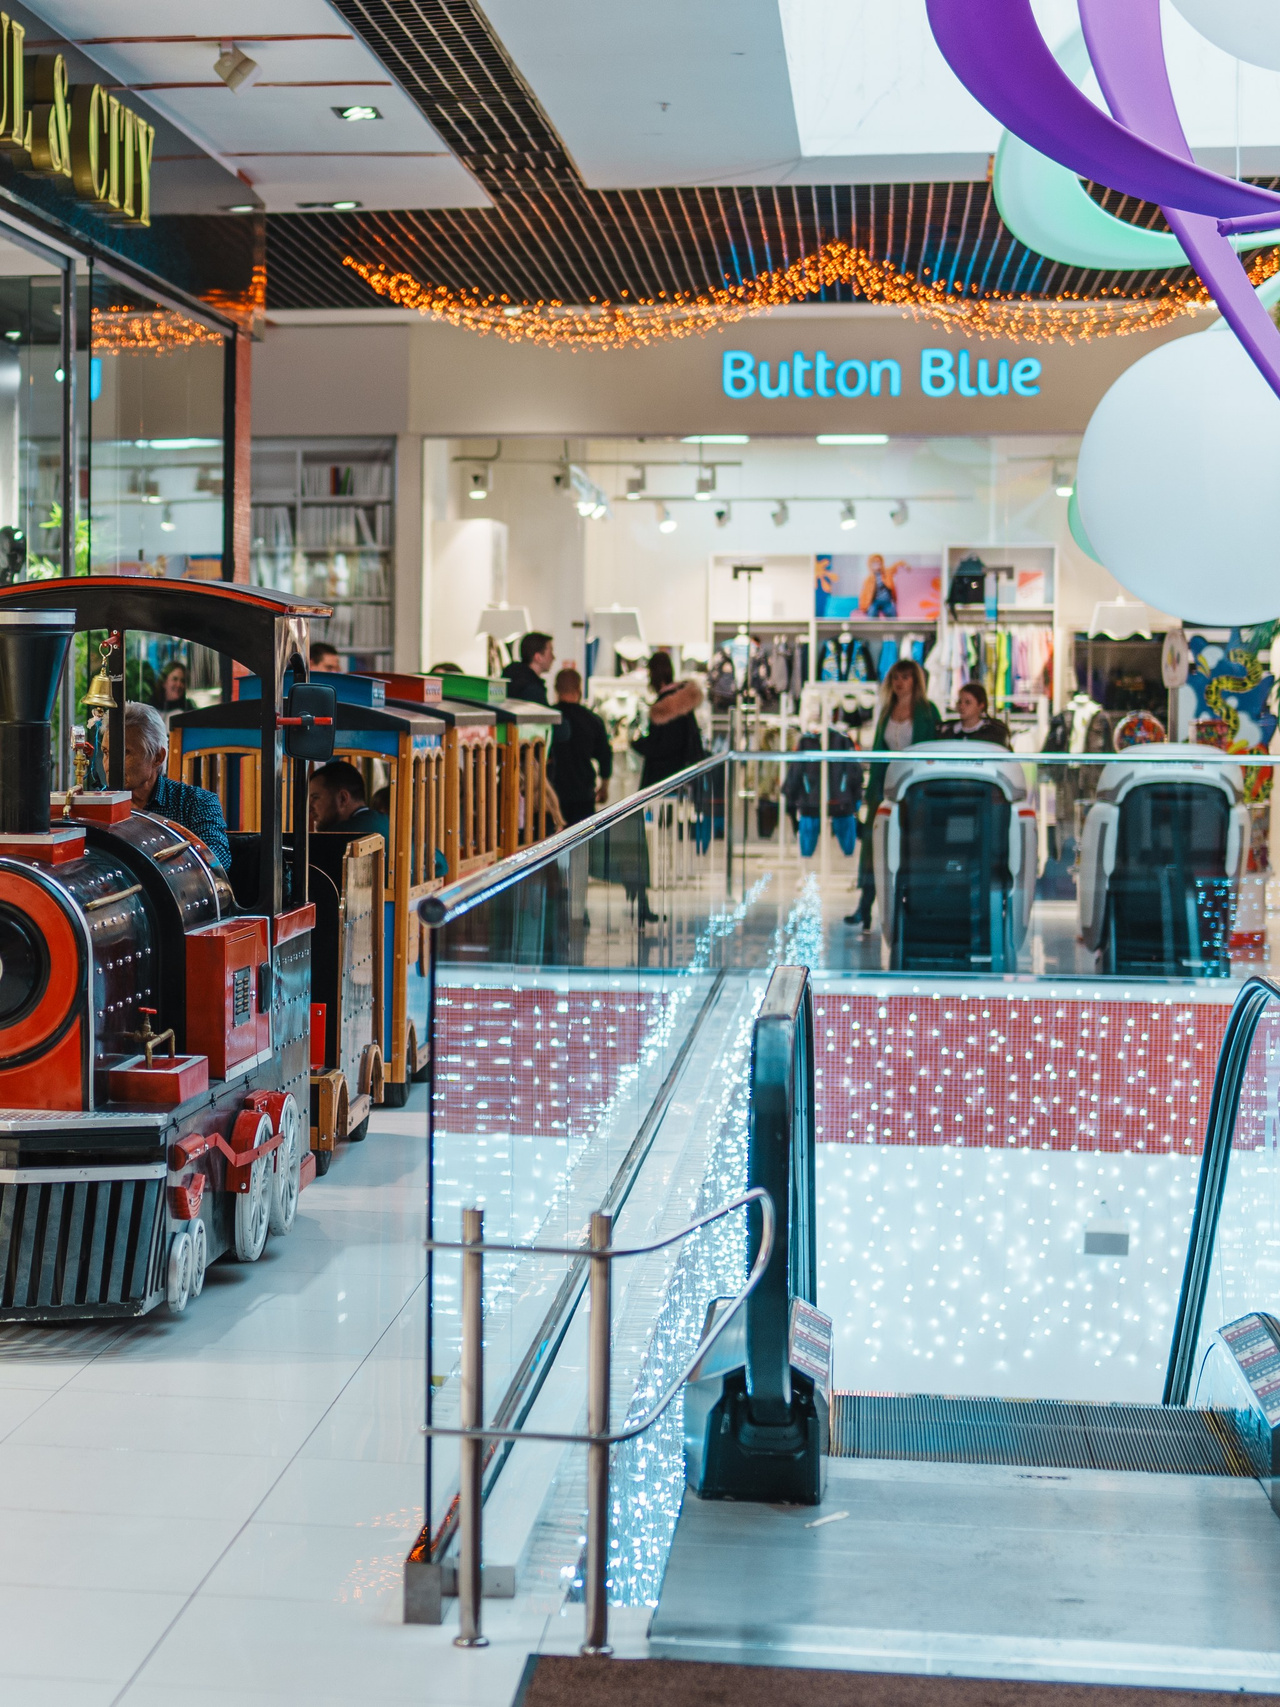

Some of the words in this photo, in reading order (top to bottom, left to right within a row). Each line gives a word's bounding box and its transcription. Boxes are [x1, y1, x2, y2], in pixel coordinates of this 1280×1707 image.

[48, 53, 72, 178] &
[88, 83, 155, 228] CITY
[722, 350, 901, 398] Button
[920, 349, 1042, 397] Blue
